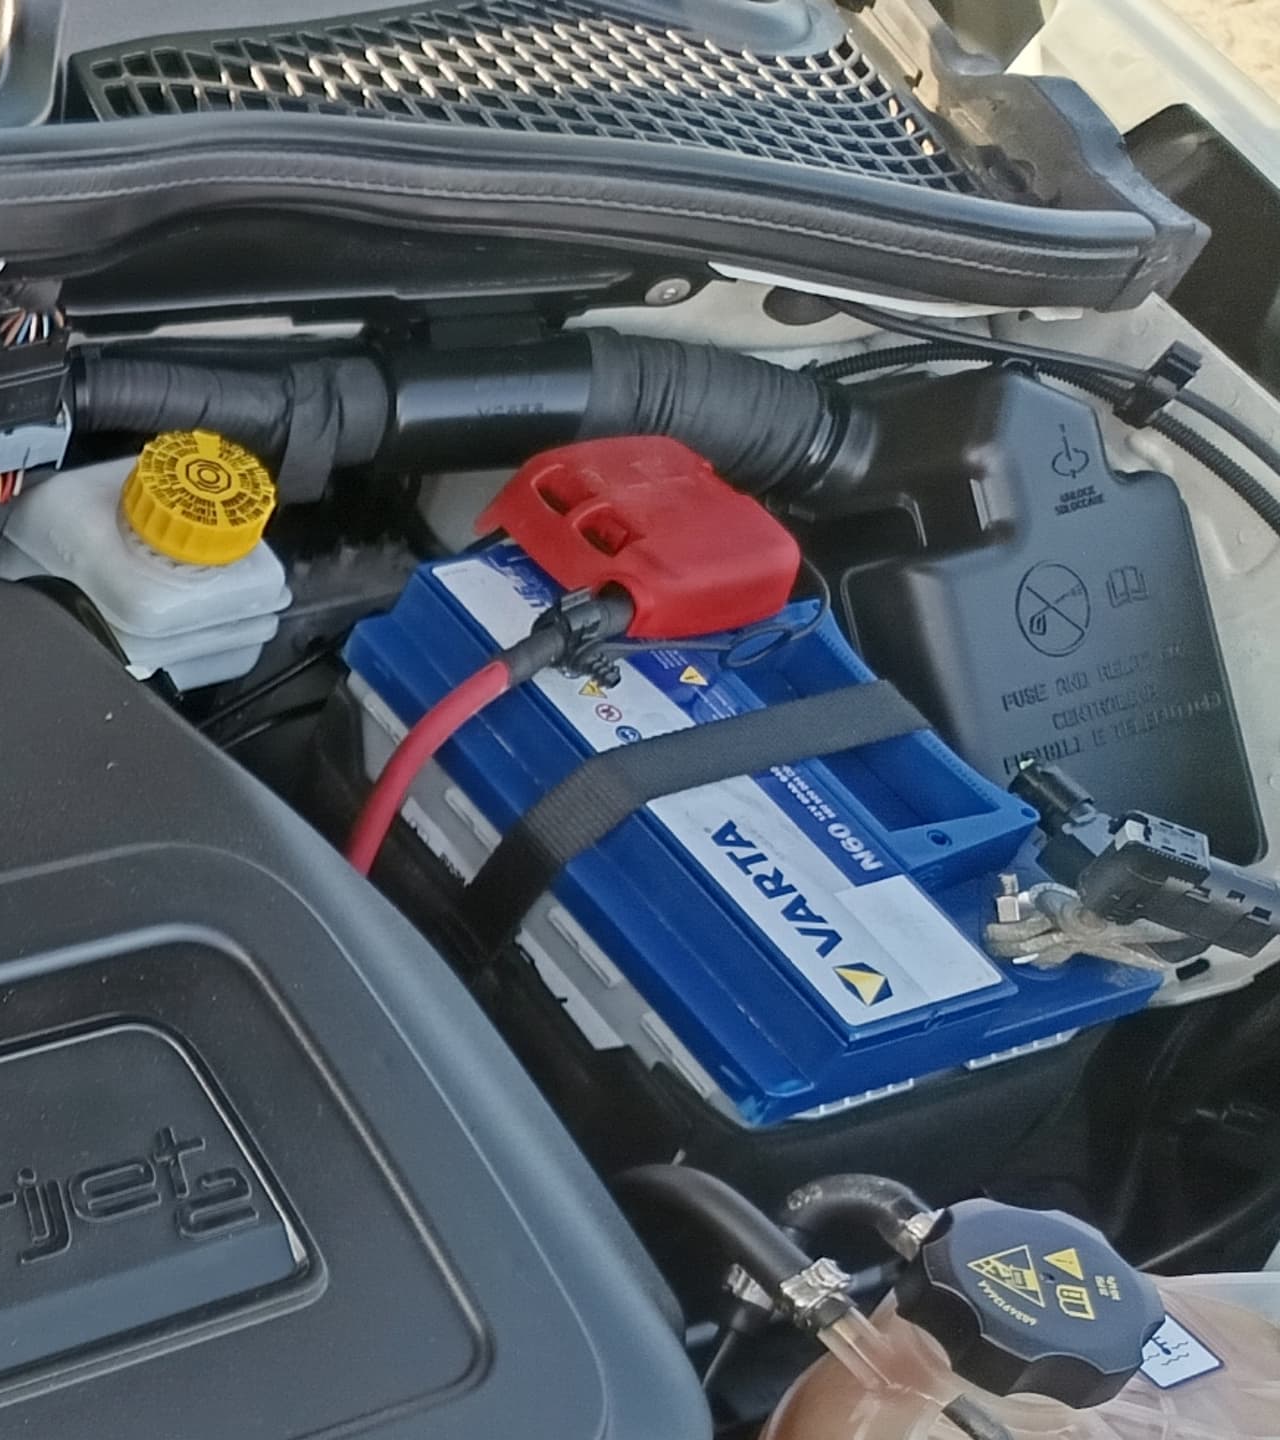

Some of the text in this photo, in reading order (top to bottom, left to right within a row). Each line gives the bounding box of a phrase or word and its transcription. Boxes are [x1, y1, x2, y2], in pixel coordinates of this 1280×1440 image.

[1001, 683, 1049, 713] FUSE
[826, 822, 884, 872] N60
[711, 819, 843, 959] VARTA
